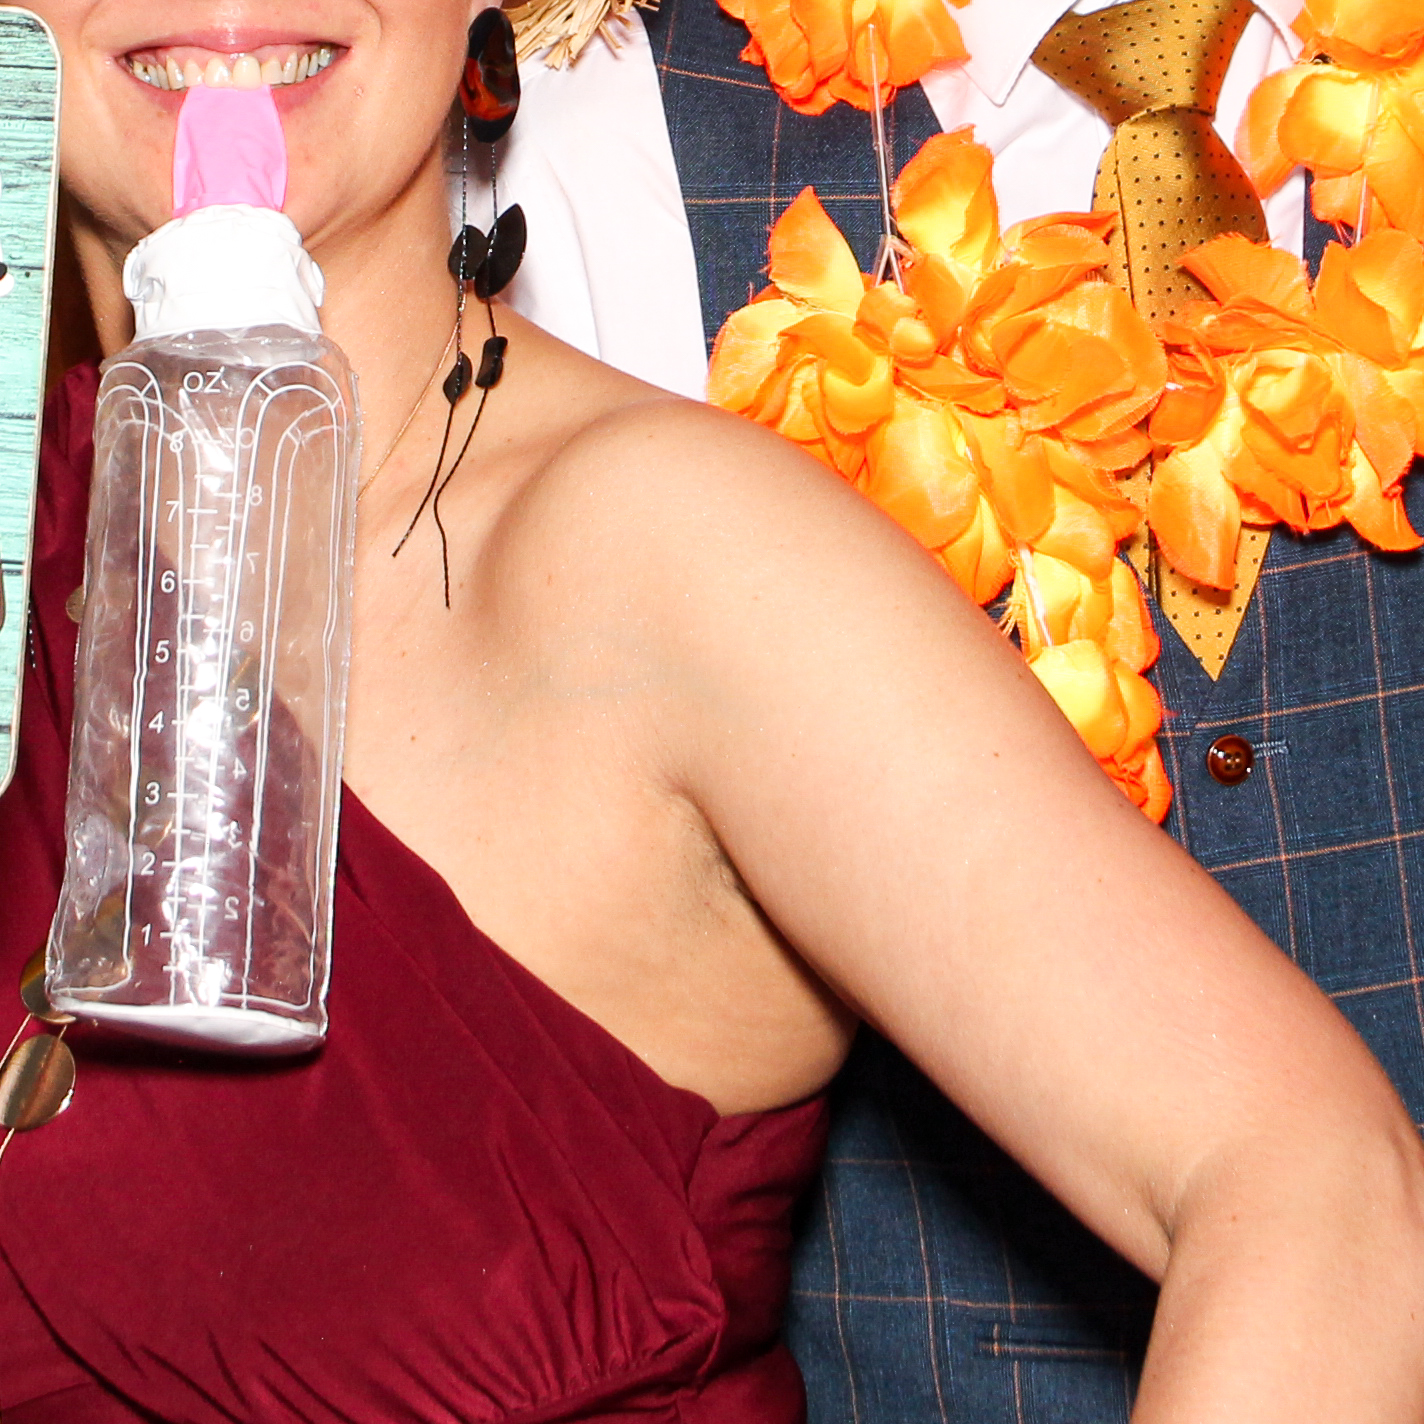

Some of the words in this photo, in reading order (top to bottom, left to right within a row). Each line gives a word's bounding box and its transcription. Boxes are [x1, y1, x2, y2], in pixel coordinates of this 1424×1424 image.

[182, 371, 223, 394] OZ
[165, 499, 181, 523] 7
[160, 569, 176, 593] 6
[154, 639, 170, 663] 5
[148, 710, 165, 734] 4
[144, 781, 160, 805] 3
[140, 851, 155, 876] 2
[141, 923, 152, 946] 1
